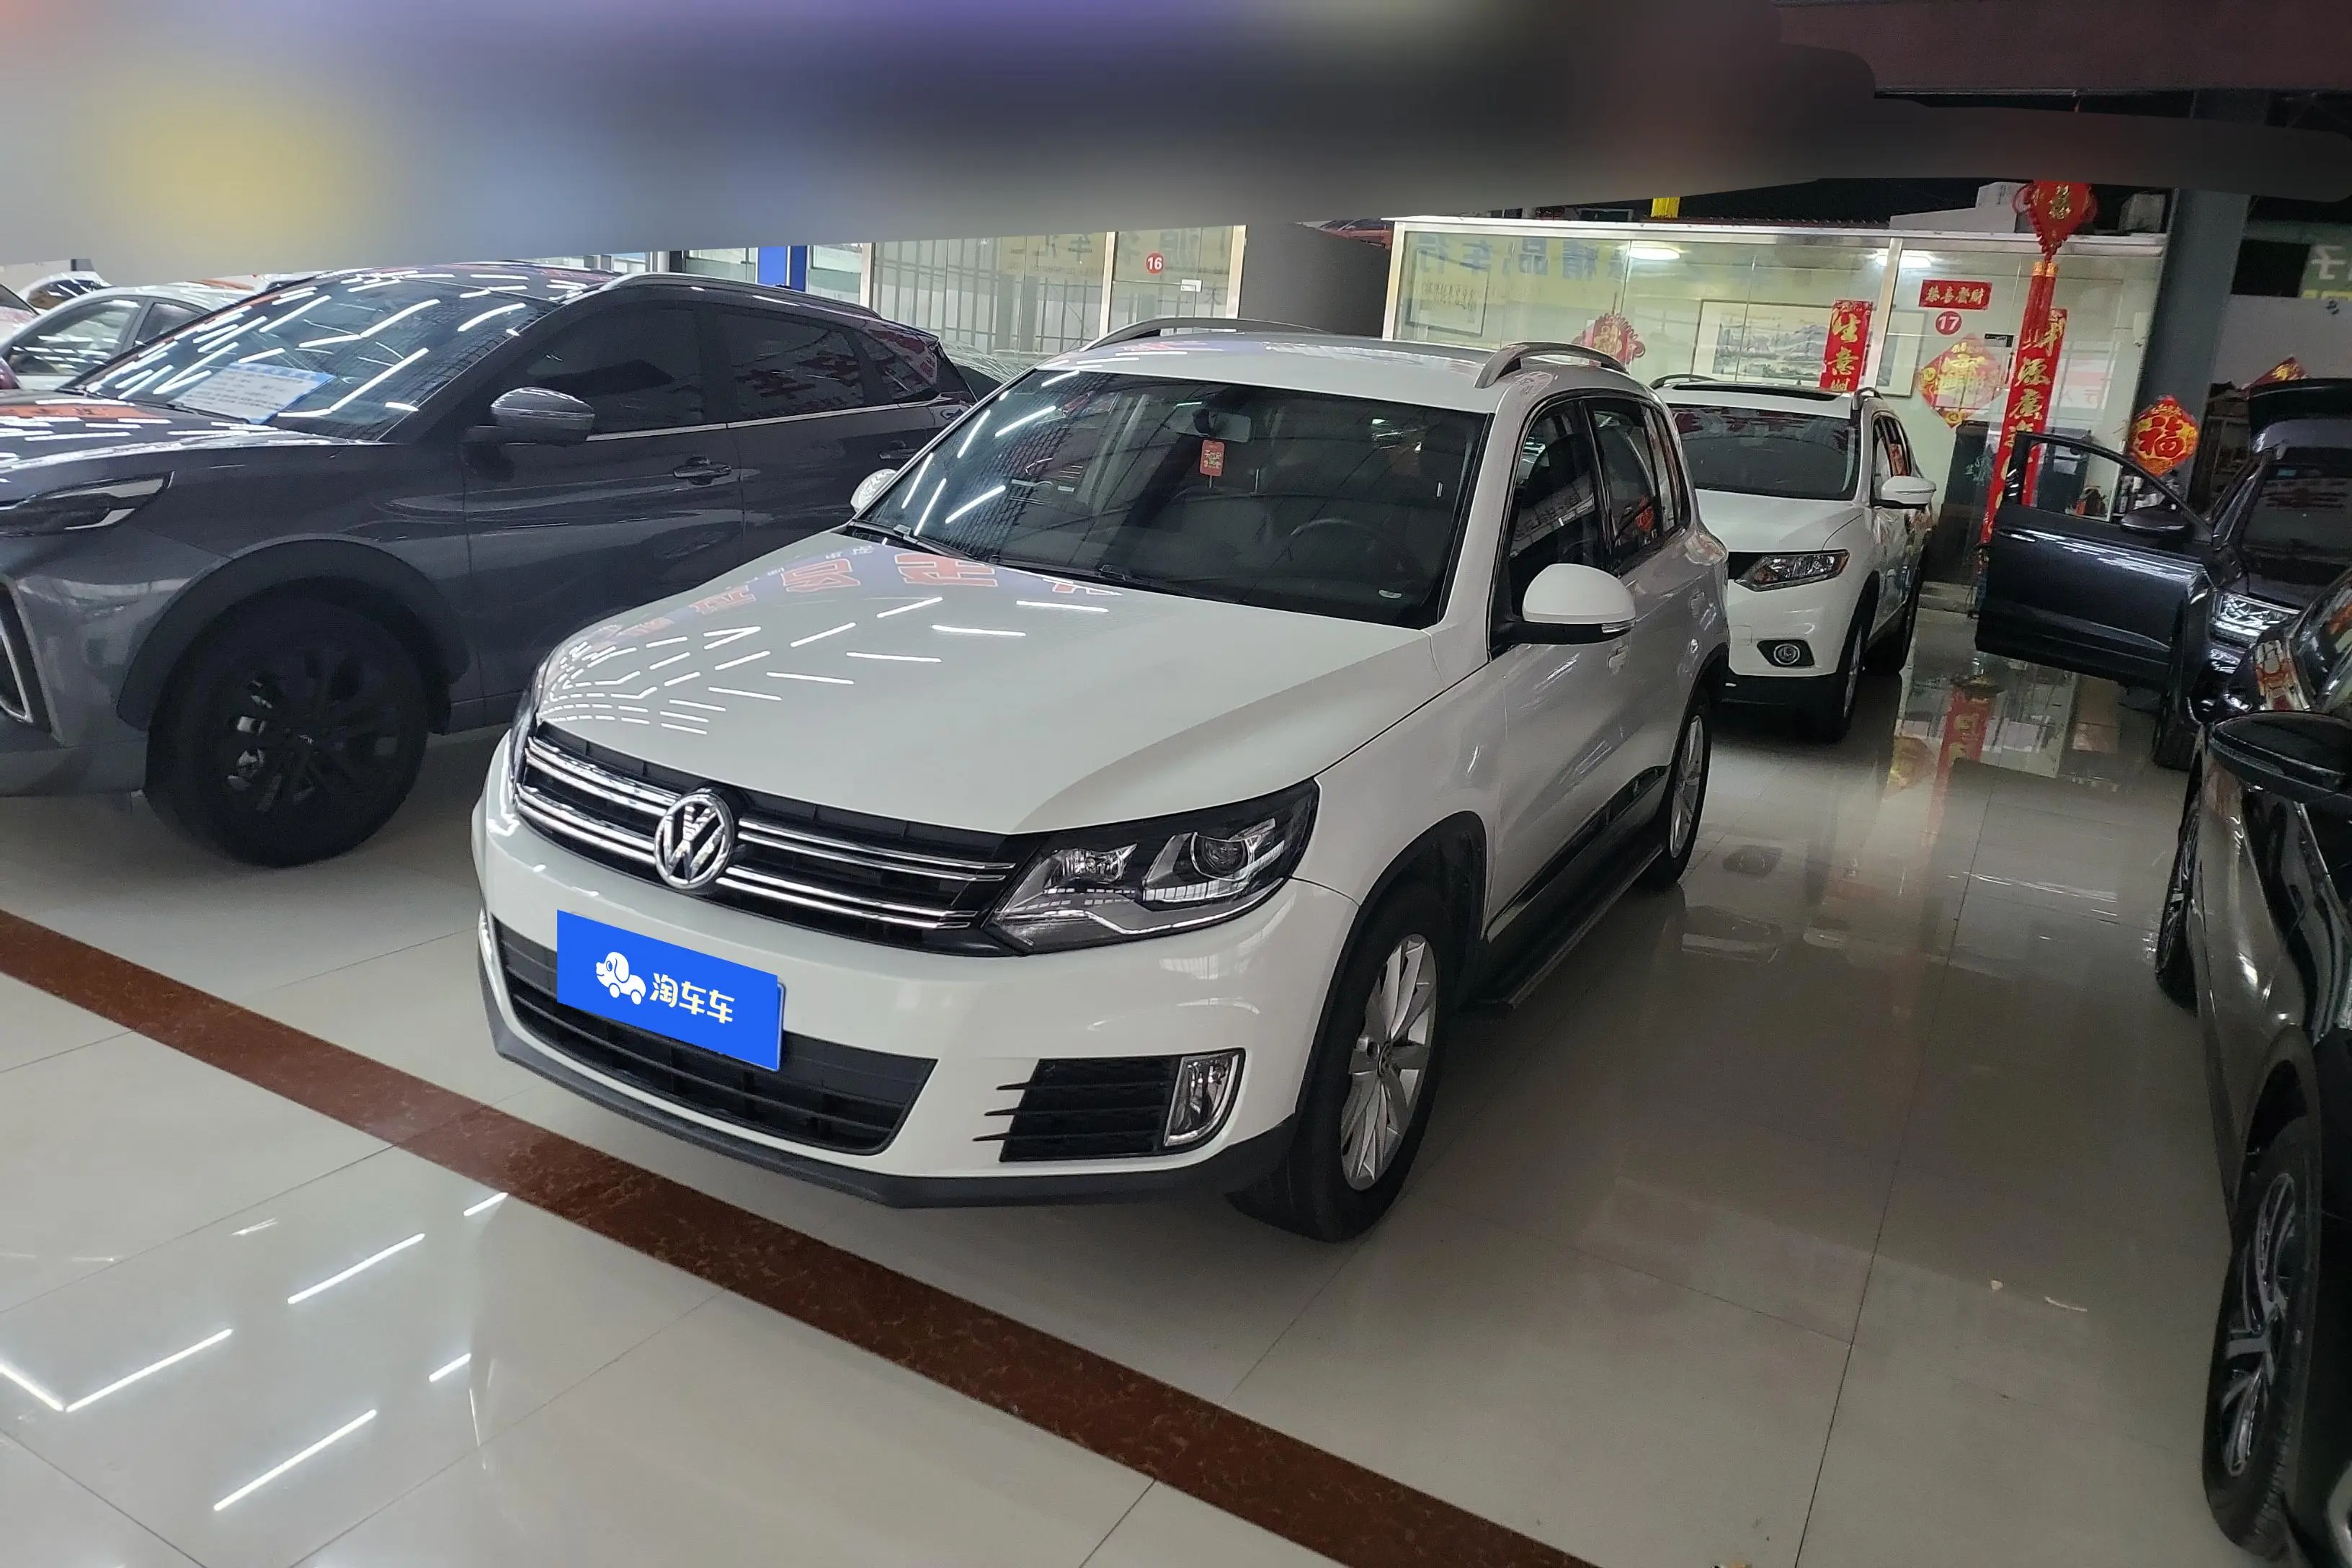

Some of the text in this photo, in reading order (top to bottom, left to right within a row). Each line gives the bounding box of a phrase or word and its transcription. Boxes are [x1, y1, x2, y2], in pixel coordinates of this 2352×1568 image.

[1147, 257, 1162, 270] 16
[1938, 315, 1959, 330] 17
[2137, 416, 2184, 458] 福
